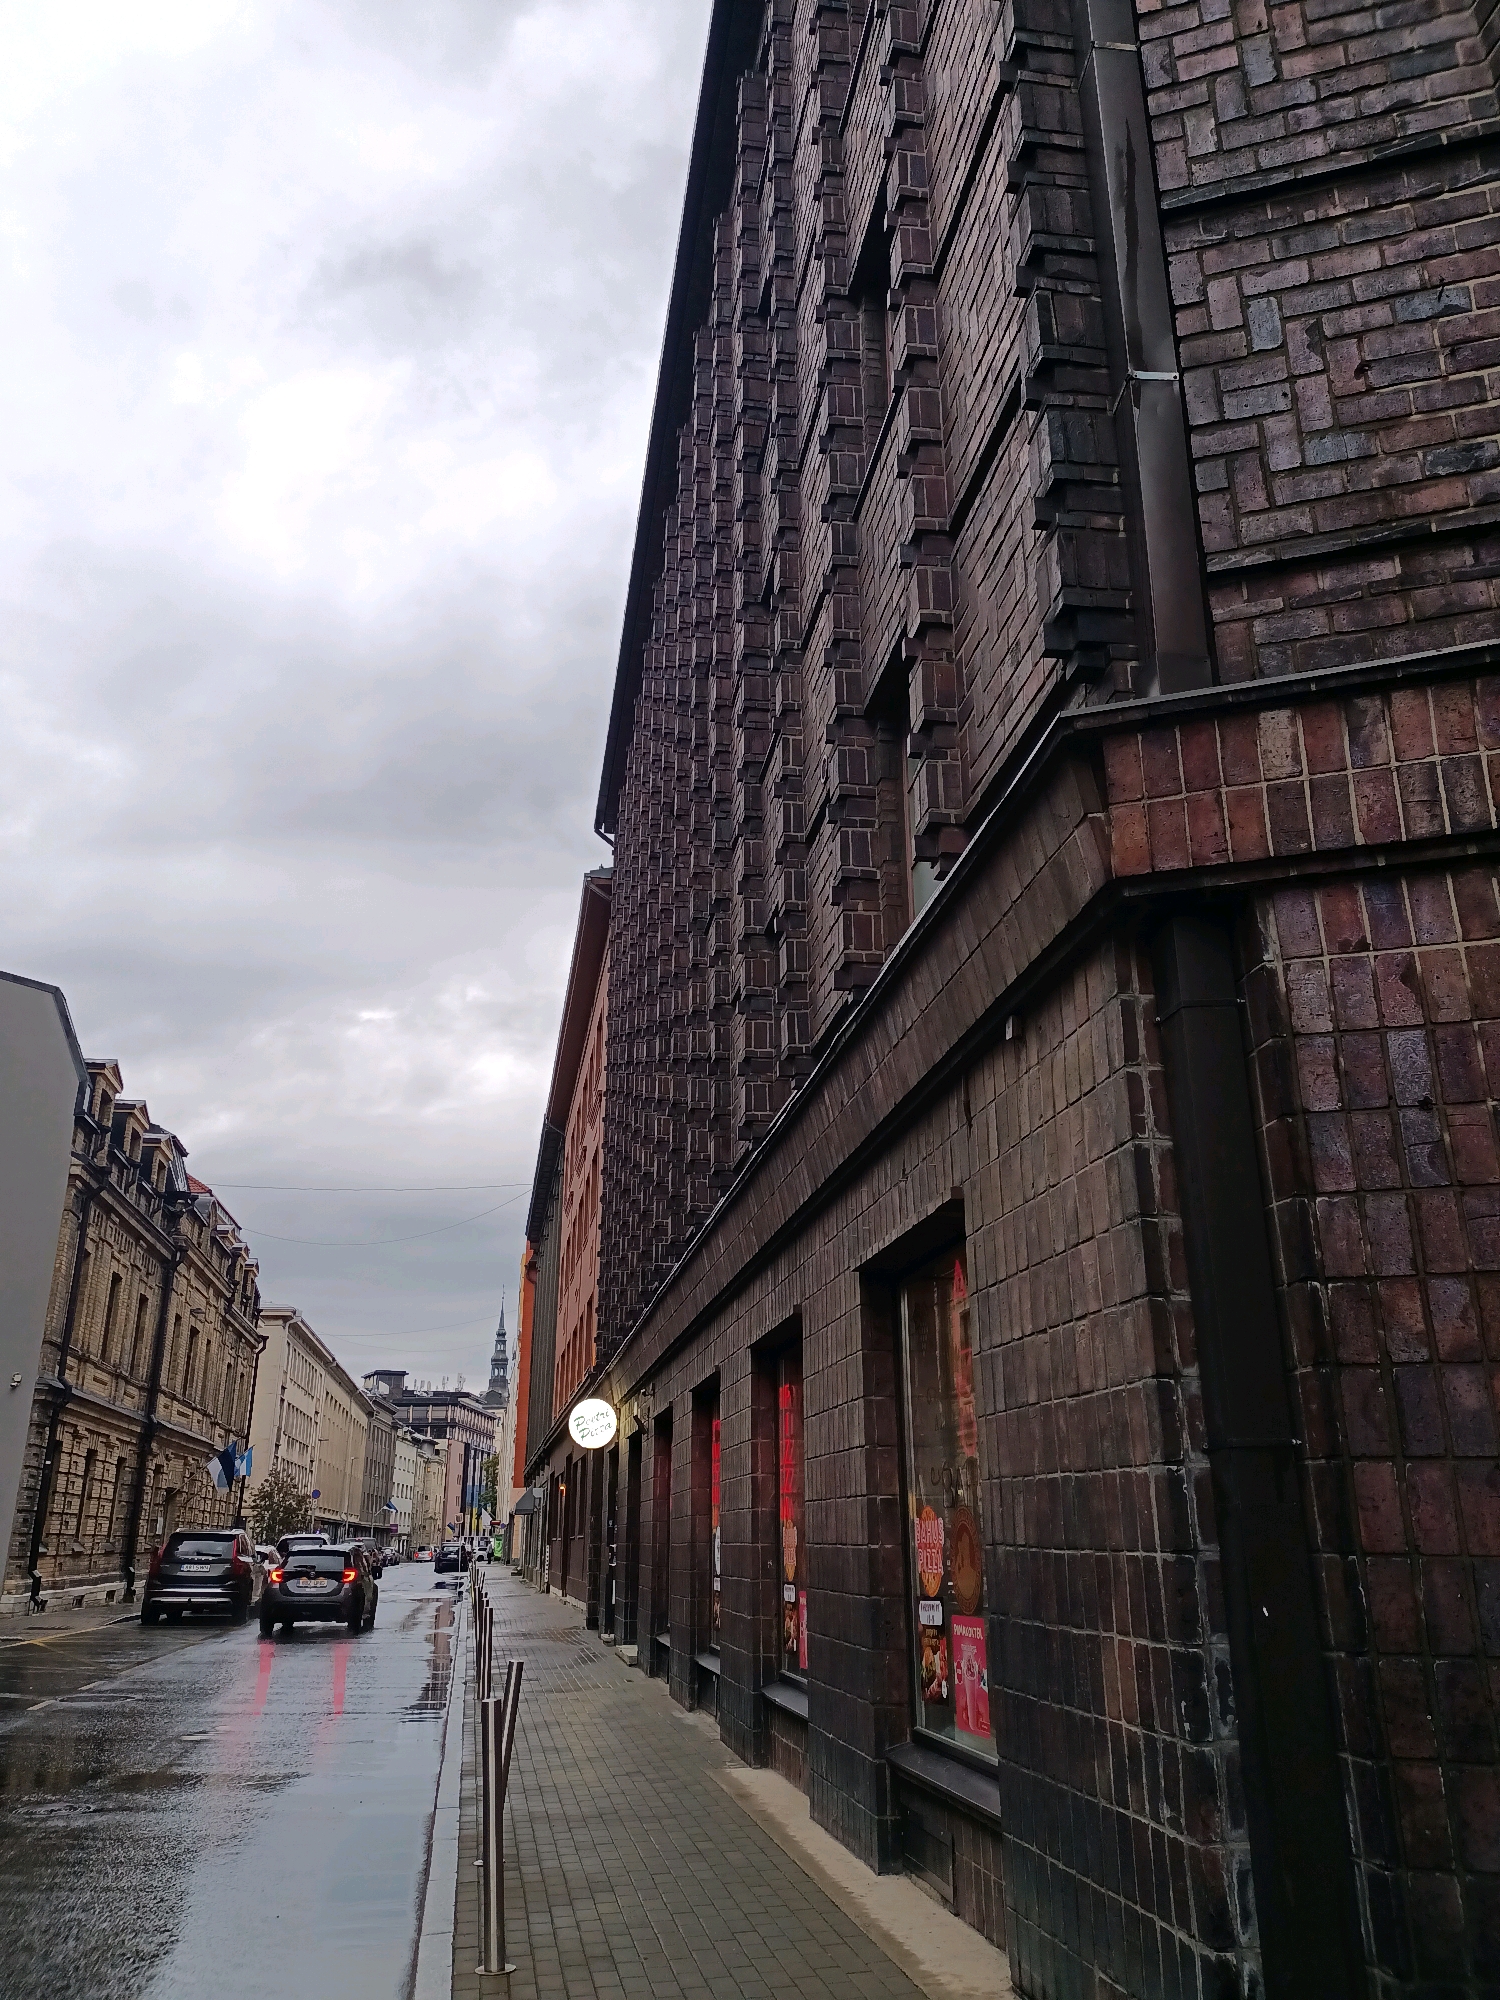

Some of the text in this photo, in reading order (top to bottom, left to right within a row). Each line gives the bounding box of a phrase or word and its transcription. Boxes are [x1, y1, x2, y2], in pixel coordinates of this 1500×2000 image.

[573, 1409, 610, 1430] Peetri
[579, 1422, 612, 1441] Pizza
[917, 1548, 944, 1575] PIZZA
